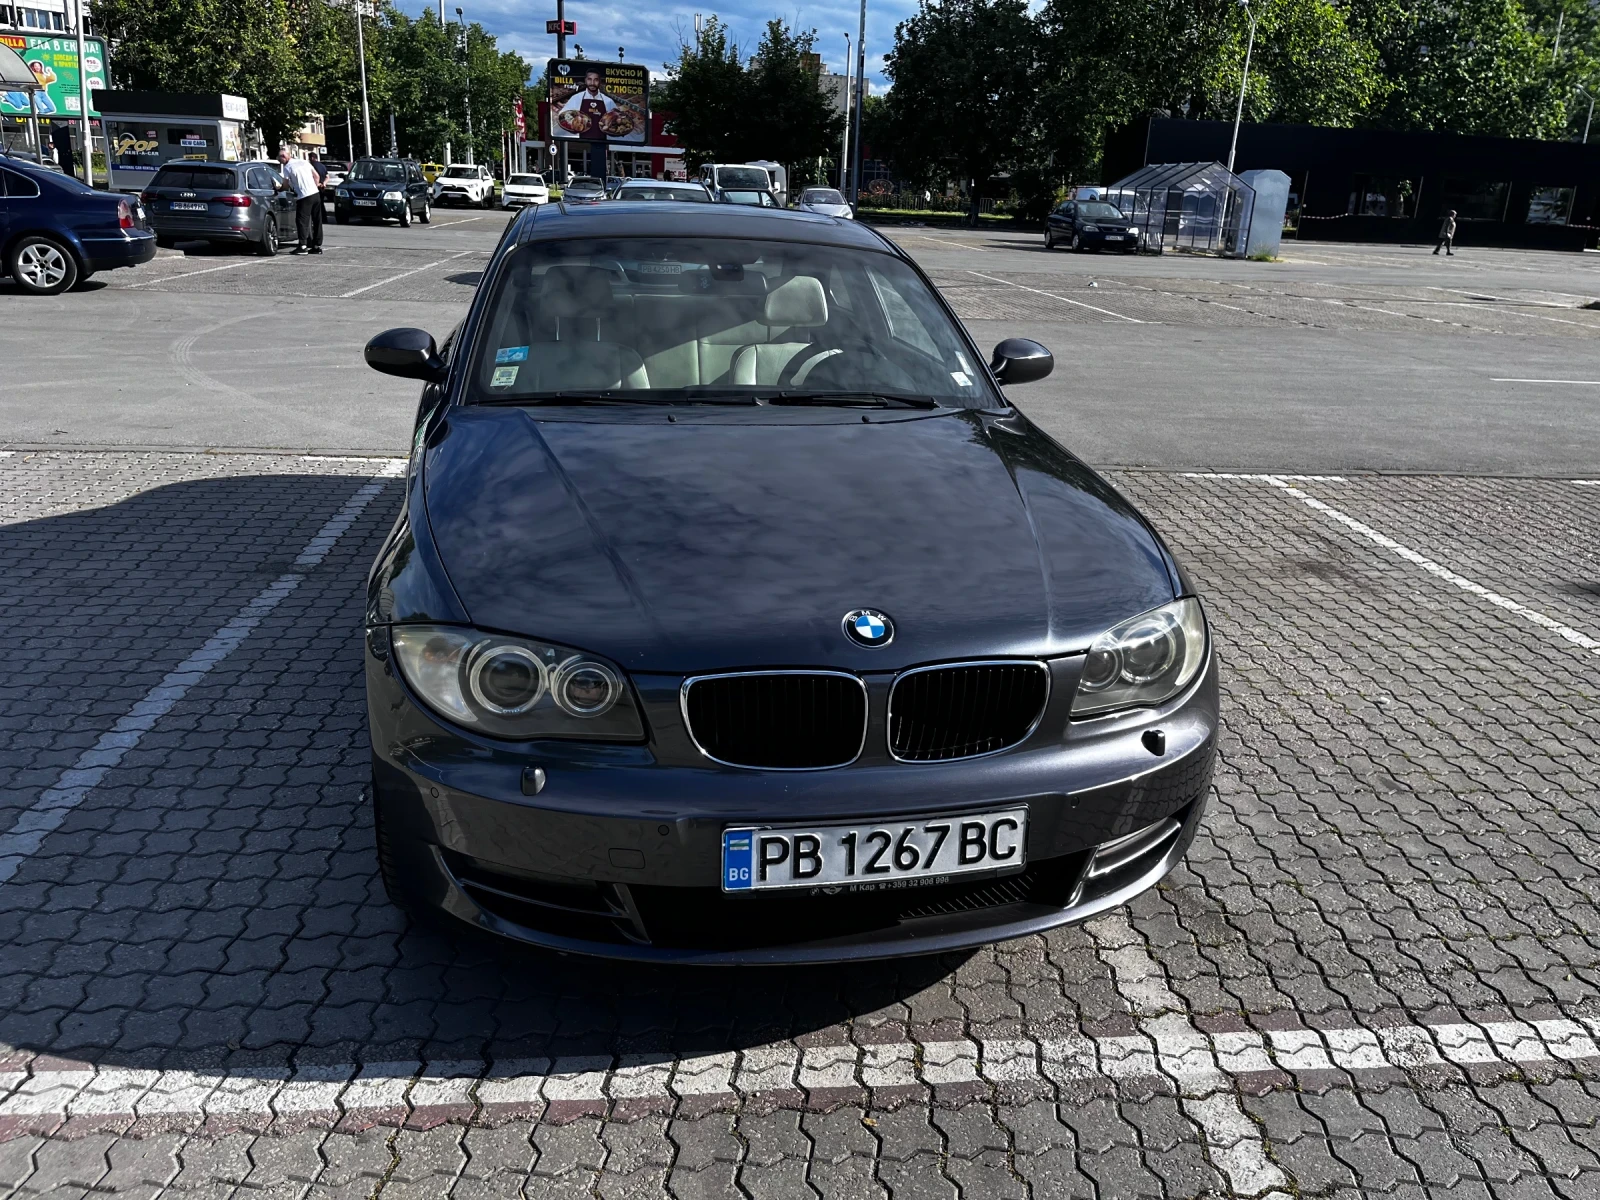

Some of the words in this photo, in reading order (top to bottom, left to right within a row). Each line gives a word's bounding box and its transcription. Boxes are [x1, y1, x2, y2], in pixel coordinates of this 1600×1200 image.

[548, 23, 561, 31] KFC
[605, 68, 636, 77] ВКУСНО
[564, 83, 579, 91] ready
[605, 85, 612, 93] С
[613, 86, 643, 94] ЛЮБОВ
[115, 140, 158, 156] TOP
[849, 610, 887, 622] BMW
[759, 834, 822, 881] PB
[841, 822, 951, 876] 1267
[958, 816, 1018, 866] BC
[729, 868, 749, 881] BG
[908, 879, 918, 887] 32
